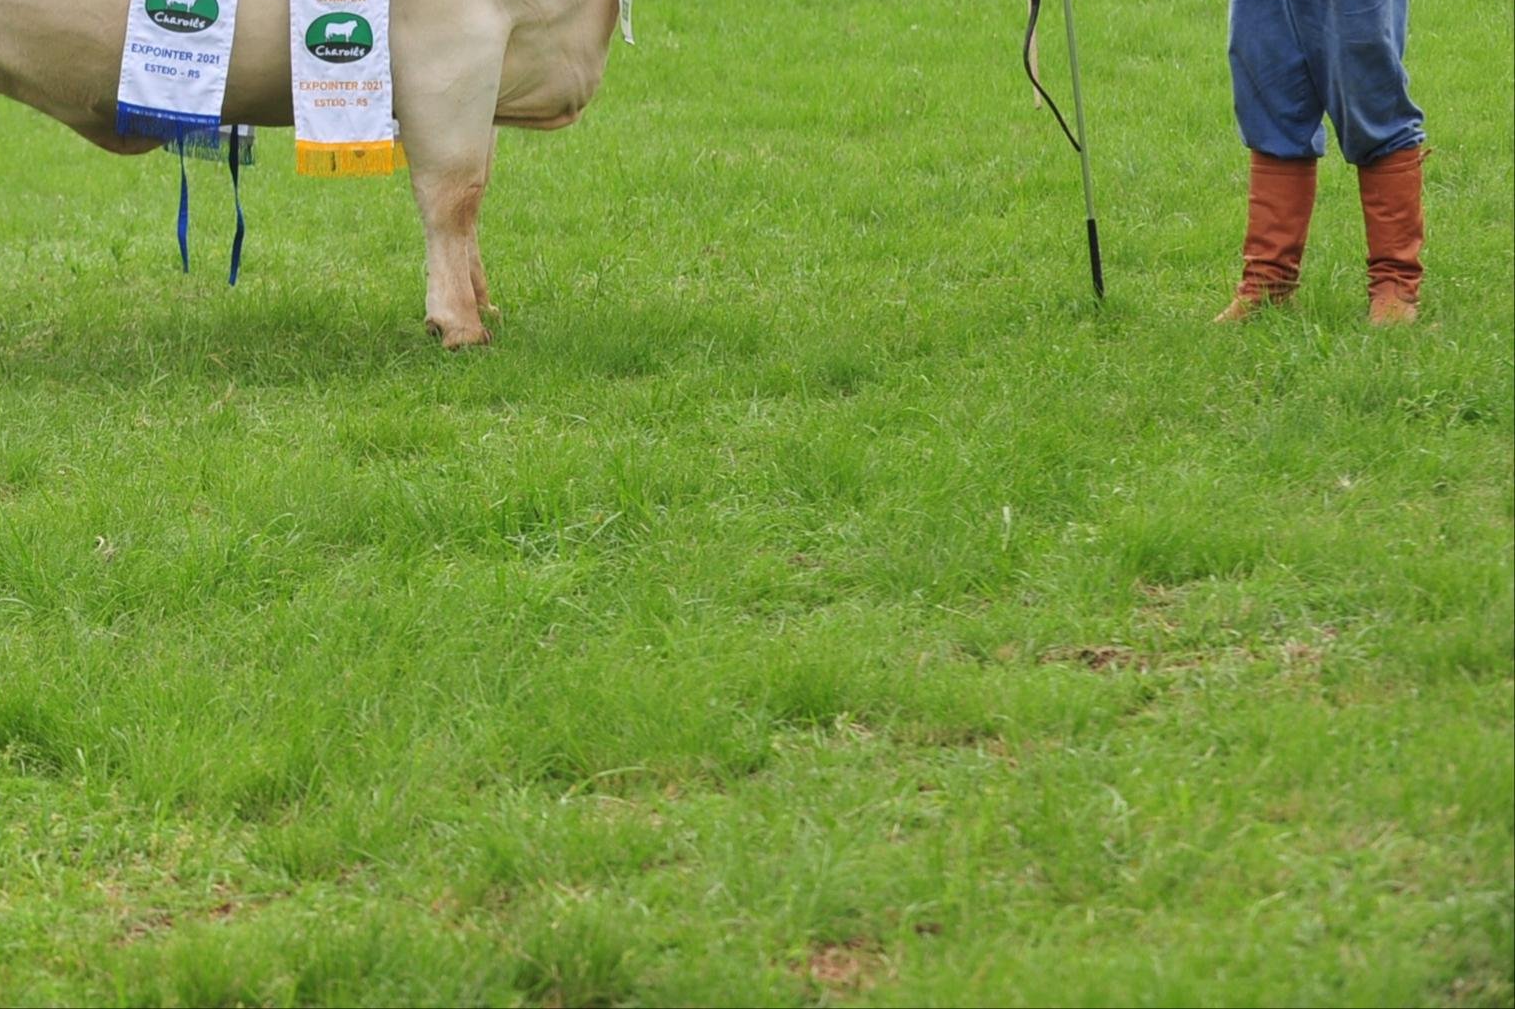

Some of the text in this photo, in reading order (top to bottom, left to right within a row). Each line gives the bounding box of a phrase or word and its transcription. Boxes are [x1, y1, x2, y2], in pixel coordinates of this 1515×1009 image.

[131, 42, 220, 65] EXPOINTER 2021
[144, 63, 178, 76] ESTEIO
[187, 69, 201, 79] RS
[299, 80, 383, 91] EXPOINTER 2021
[314, 98, 347, 108] ESTEIO
[355, 97, 368, 107] RS
